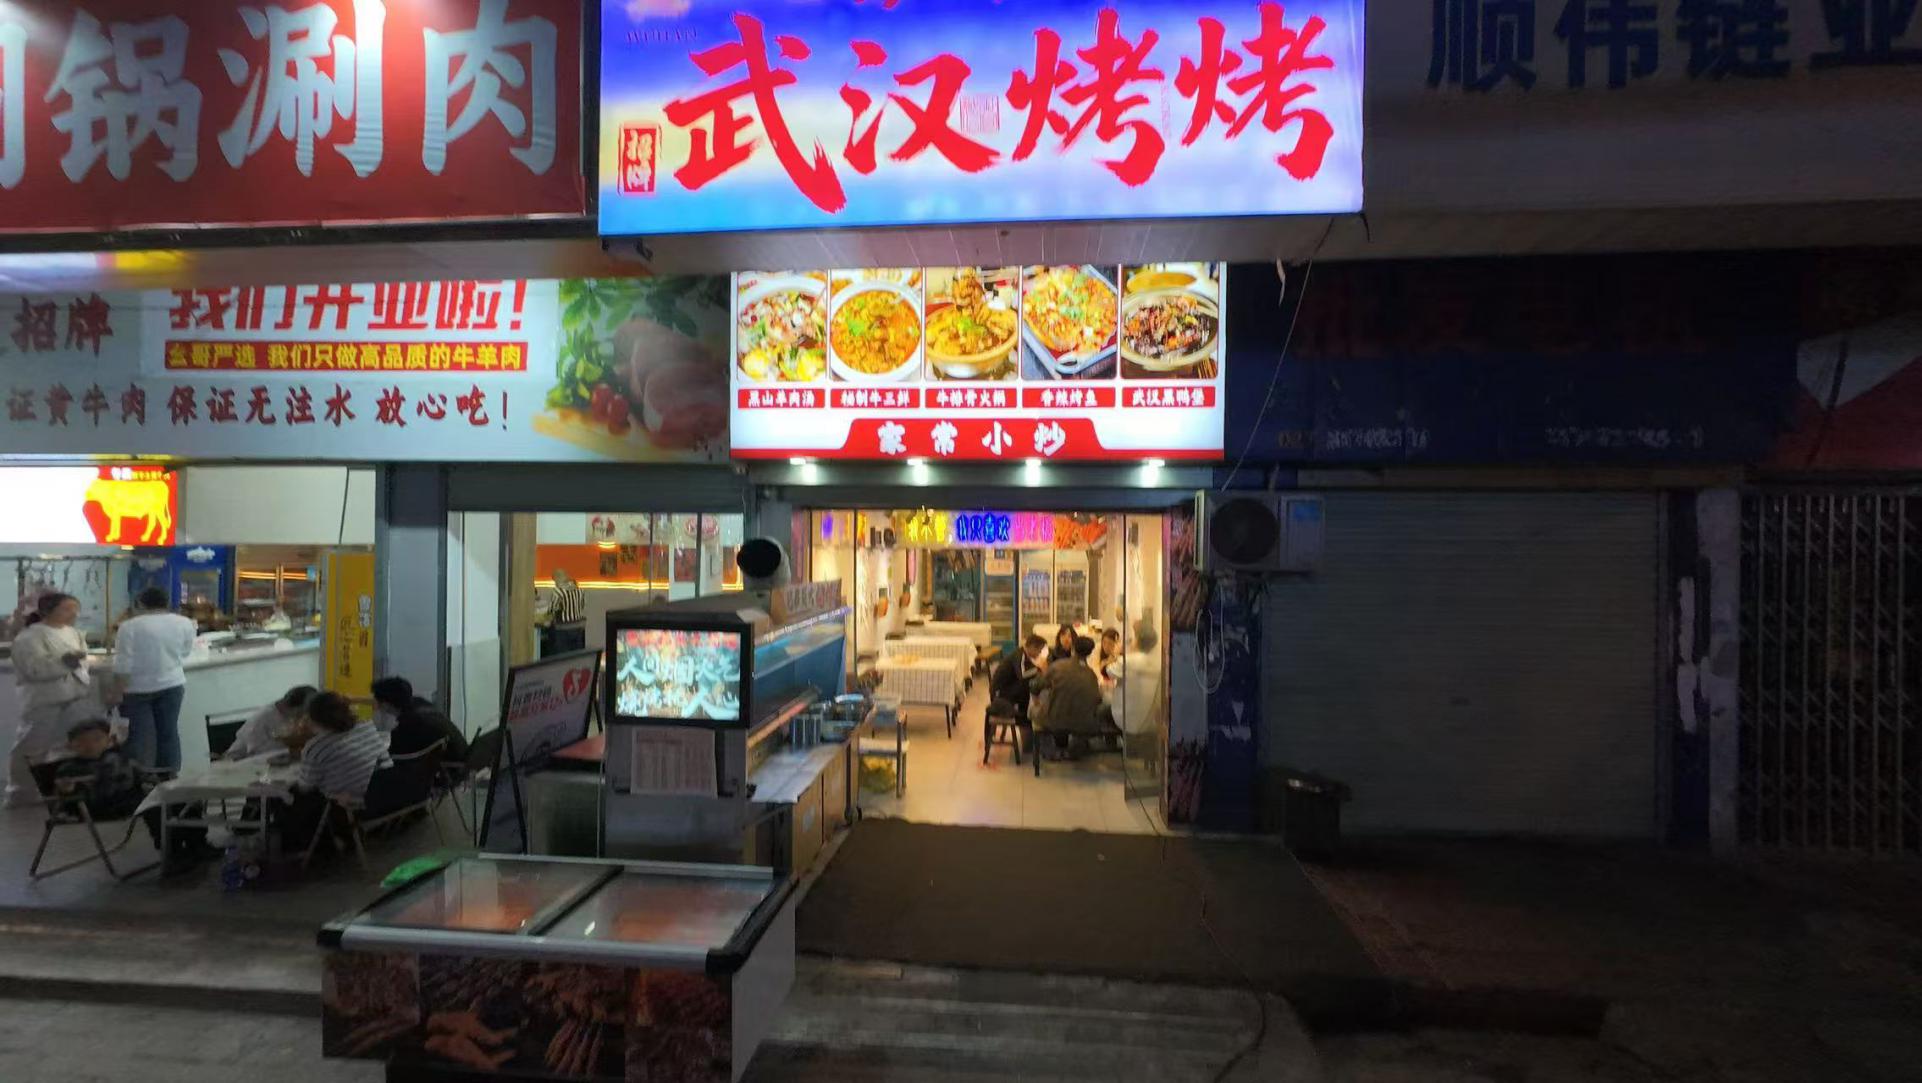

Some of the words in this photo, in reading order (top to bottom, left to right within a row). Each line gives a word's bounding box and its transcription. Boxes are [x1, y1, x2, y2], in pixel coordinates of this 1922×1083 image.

[664, 3, 1335, 213] 武汉烤烤
[267, 343, 521, 370] 我们只做高品质的牛羊肉
[6, 384, 147, 427] 证黄牛肉
[167, 384, 356, 427] 保证无注水
[377, 384, 509, 430] 放心吃!
[877, 420, 1066, 456] 家常小炒
